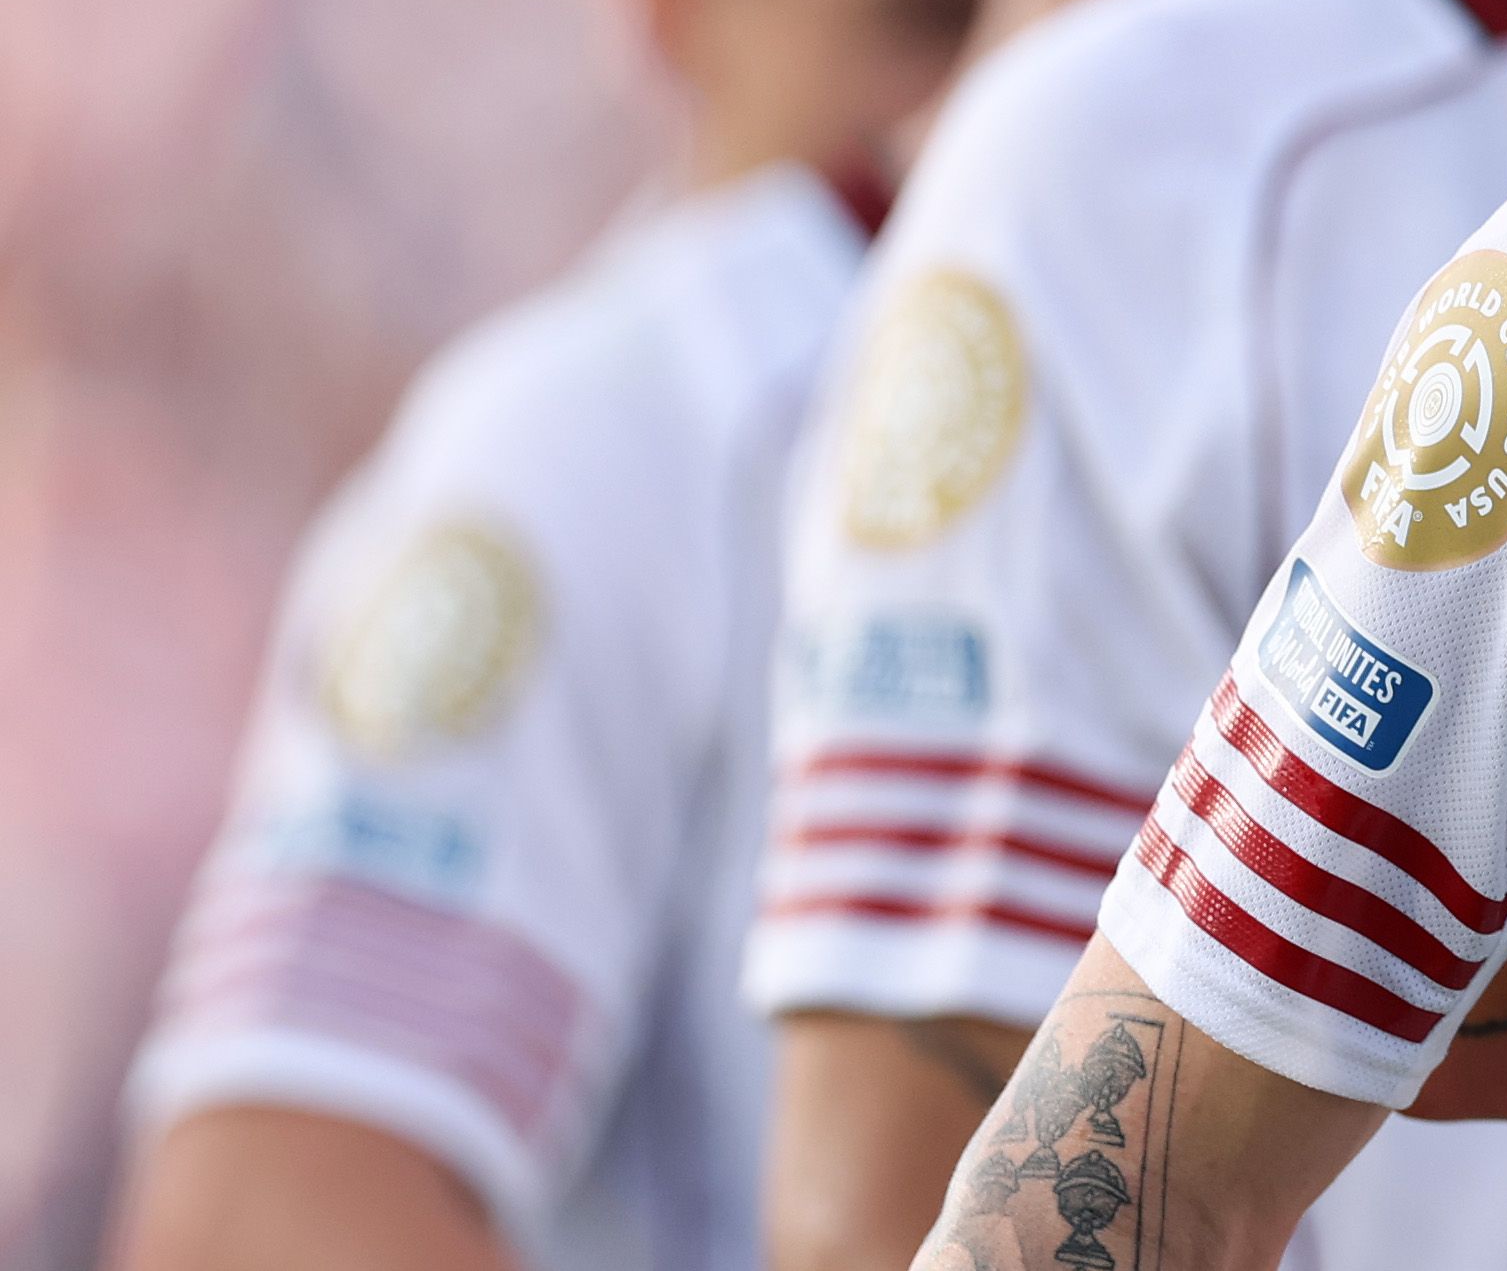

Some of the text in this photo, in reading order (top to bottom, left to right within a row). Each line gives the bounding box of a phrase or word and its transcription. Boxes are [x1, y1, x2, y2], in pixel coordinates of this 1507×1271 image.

[1419, 281, 1502, 333] WORLD
[1360, 460, 1413, 548] FIFA
[1326, 629, 1402, 704] UNITES
[1318, 686, 1369, 737] FIFA
